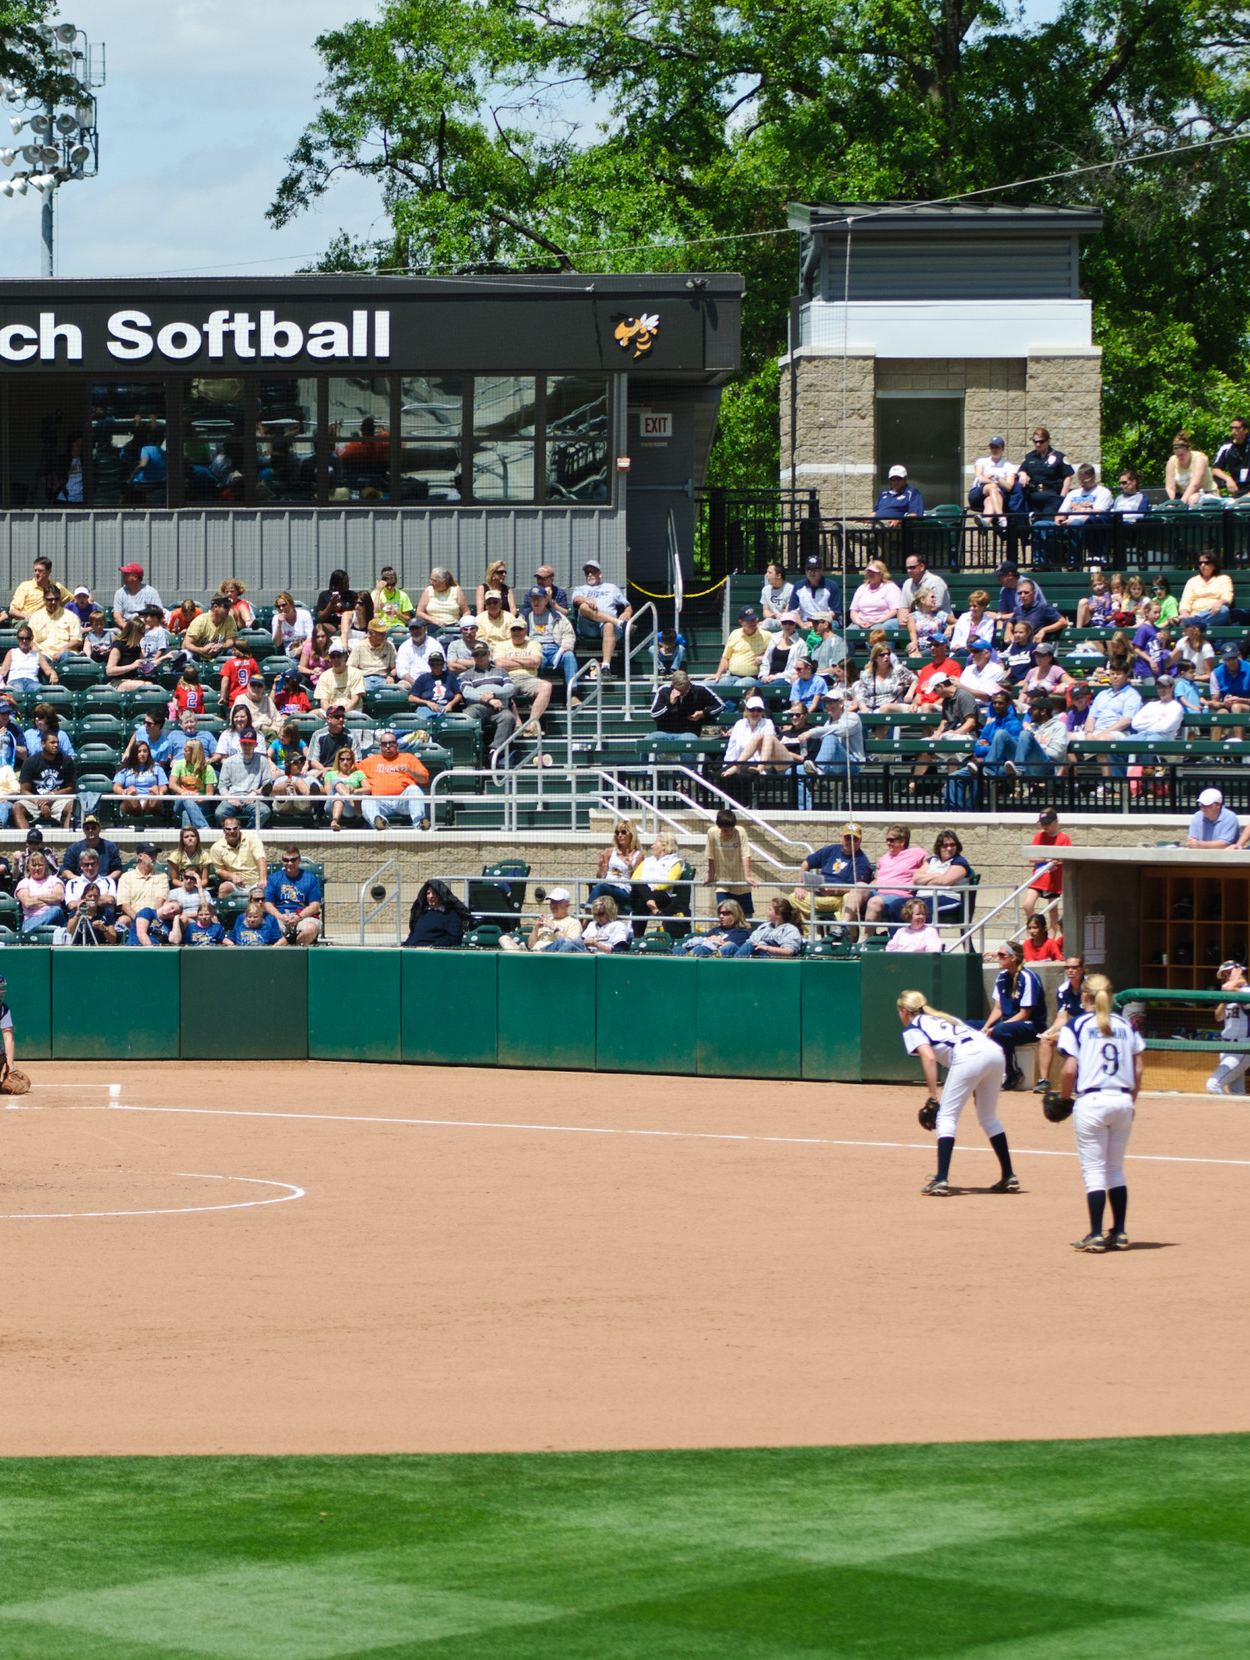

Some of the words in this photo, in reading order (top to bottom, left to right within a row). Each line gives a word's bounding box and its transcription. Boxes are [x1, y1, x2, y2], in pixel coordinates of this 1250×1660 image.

[106, 310, 390, 359] Softball
[645, 417, 668, 433] EXIT
[238, 669, 248, 685] 9
[187, 692, 197, 707] 2
[1101, 1043, 1119, 1076] 9
